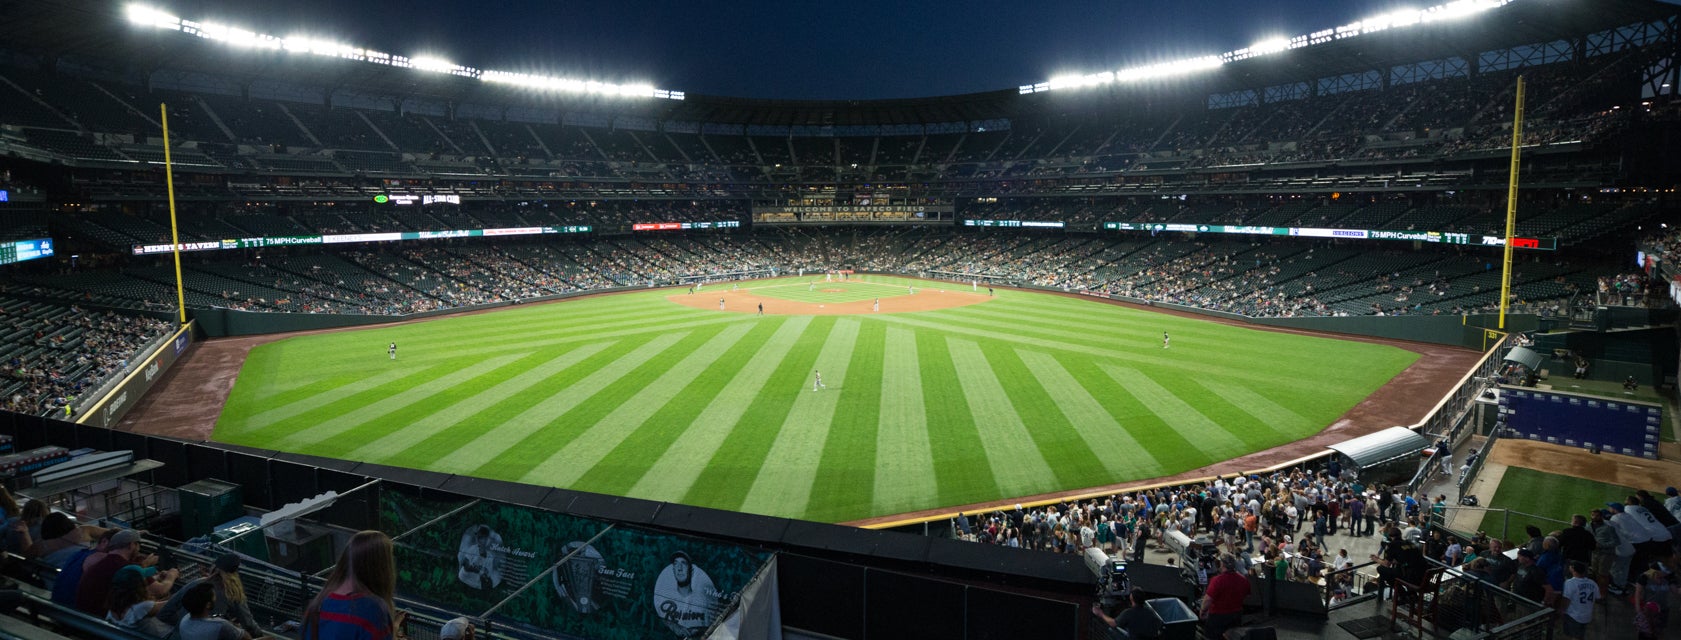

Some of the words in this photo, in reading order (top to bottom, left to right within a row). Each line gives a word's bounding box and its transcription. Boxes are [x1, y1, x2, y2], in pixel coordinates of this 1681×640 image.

[423, 195, 446, 205] ALL-STAR
[447, 195, 460, 205] CLUB
[266, 237, 274, 245] 75
[274, 237, 292, 245] MPH
[292, 236, 322, 244] Curveball
[1380, 231, 1397, 239] MPH
[1397, 232, 1428, 241] Curveball
[144, 243, 184, 253] HENRYS
[186, 242, 220, 250] TAVERN
[1488, 331, 1497, 339] 331
[512, 547, 536, 558] Award
[598, 565, 615, 576] Fun
[615, 567, 635, 580] Fact
[1579, 591, 1595, 604] 24
